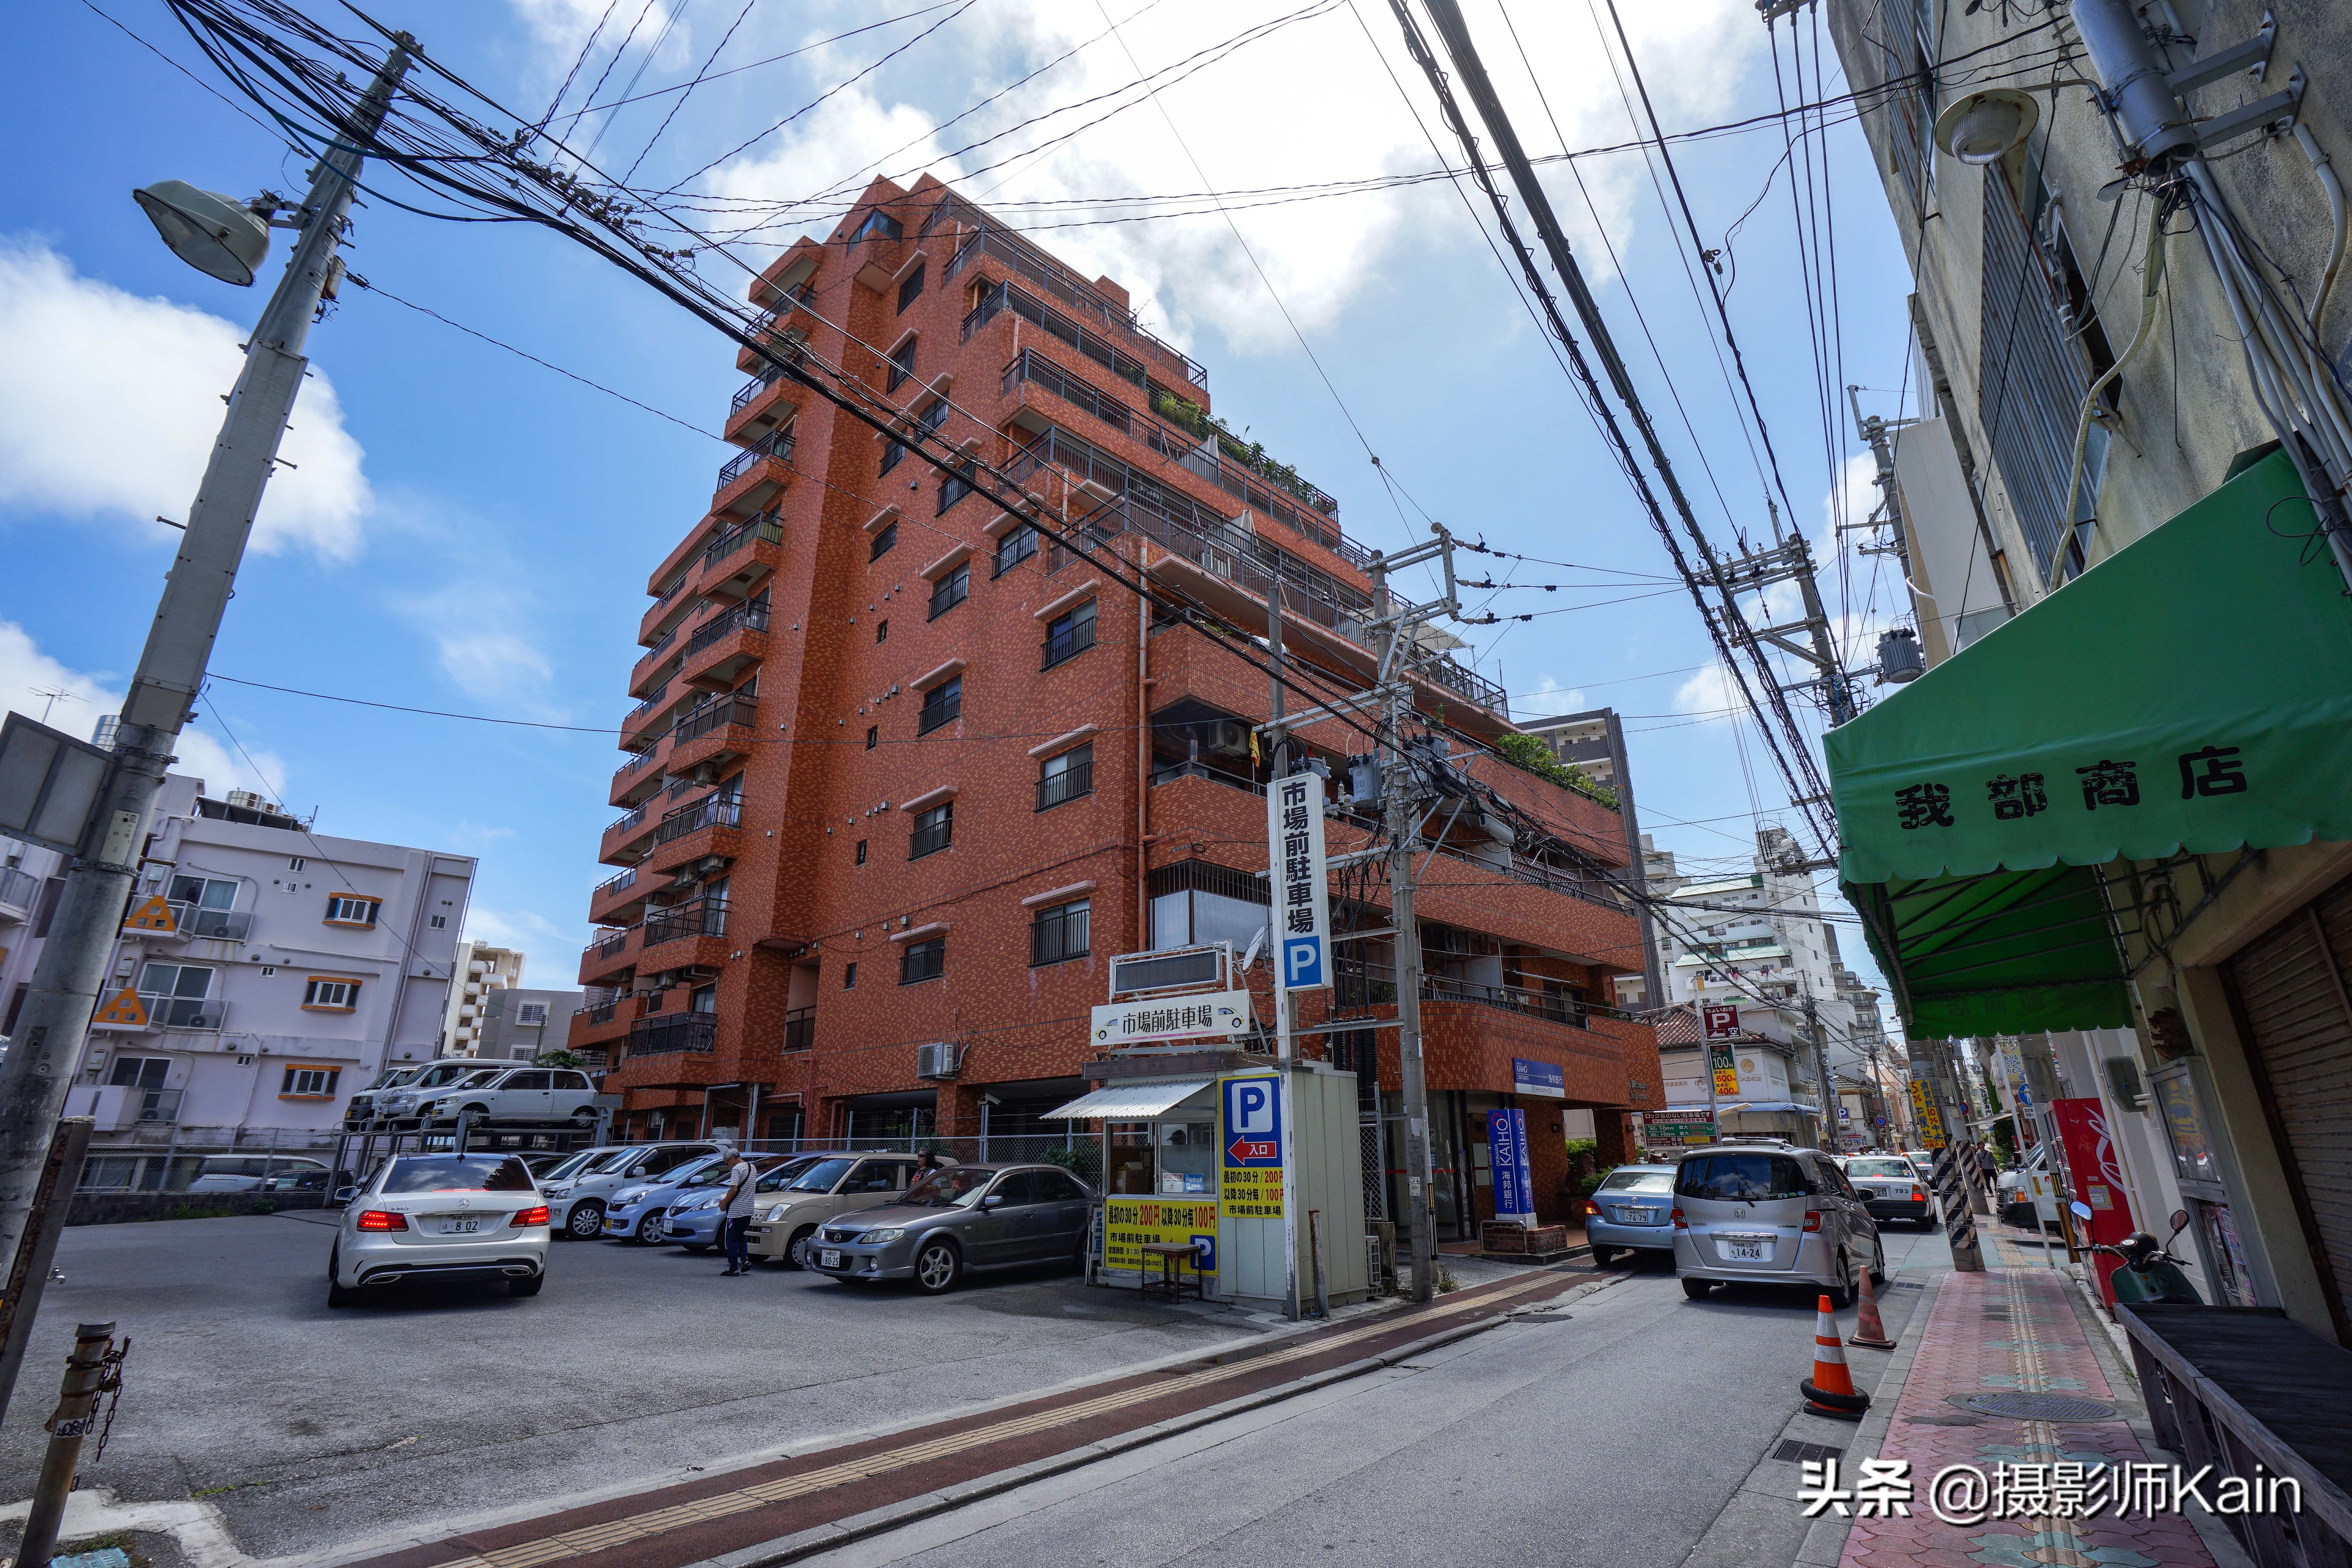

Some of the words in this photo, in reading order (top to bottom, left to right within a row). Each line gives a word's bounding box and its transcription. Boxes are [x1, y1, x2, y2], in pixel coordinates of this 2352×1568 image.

[1895, 745, 2248, 830] 我部商店
[1282, 782, 1314, 934] 市場前駐車場
[1290, 944, 1316, 981] P
[1123, 1005, 1212, 1034] 市場前駐車場
[1711, 1013, 1730, 1028] P
[1728, 1026, 1739, 1037] 空
[1516, 1065, 1528, 1073] KAIHO
[1713, 1056, 1733, 1069] 100円
[1548, 1074, 1562, 1085] 海邦銀行
[1240, 1087, 1265, 1128] P
[1838, 1109, 1847, 1118] P
[1496, 1118, 1512, 1166] KAIHO
[1518, 1118, 1528, 1166] KAIHO
[1249, 1144, 1268, 1156] 入口
[1224, 1171, 1258, 1183] 最初の30分
[1224, 1188, 1259, 1201] 以降30分毎
[1502, 1171, 1513, 1209] 海邦銀行
[1109, 1205, 1138, 1225] 最初の30分
[1140, 1205, 1159, 1227] 200円
[1161, 1207, 1193, 1228] 以降30分毎
[1194, 1206, 1215, 1229] 100円
[1229, 1205, 1281, 1216] 市場前駐車場
[1110, 1232, 1160, 1244] 市場前駐車場
[1108, 1246, 1124, 1254] 営業時間
[1195, 1238, 1211, 1267] P
[1737, 1249, 1760, 1257] 14-24
[825, 1257, 838, 1266] 80-25
